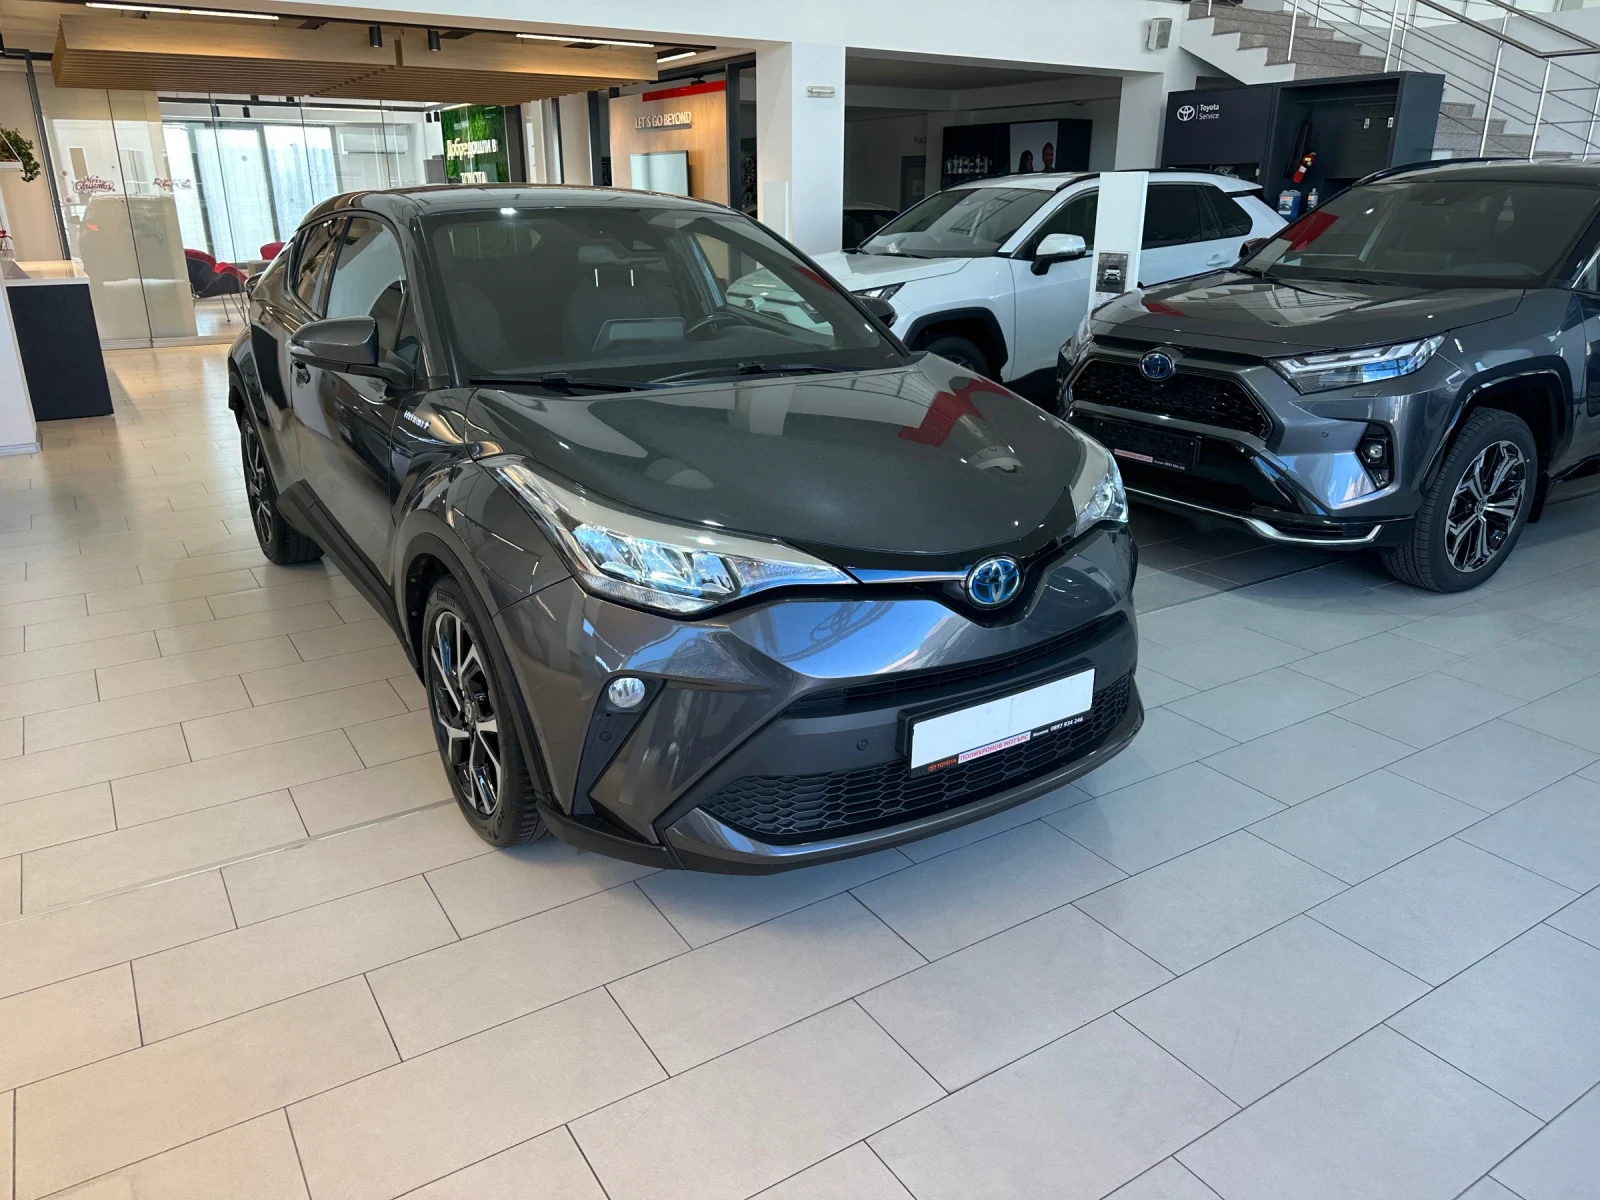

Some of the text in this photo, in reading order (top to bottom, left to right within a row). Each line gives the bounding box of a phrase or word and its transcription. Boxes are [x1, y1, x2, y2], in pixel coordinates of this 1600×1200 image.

[1200, 104, 1219, 112] Toyota
[652, 115, 663, 127] GO
[663, 111, 692, 126] BEYOND
[460, 171, 487, 183] TOYOTA
[960, 734, 1029, 761] ПОЛИХРОНОВ МОТЪРС
[936, 758, 957, 769] TOYOTA
